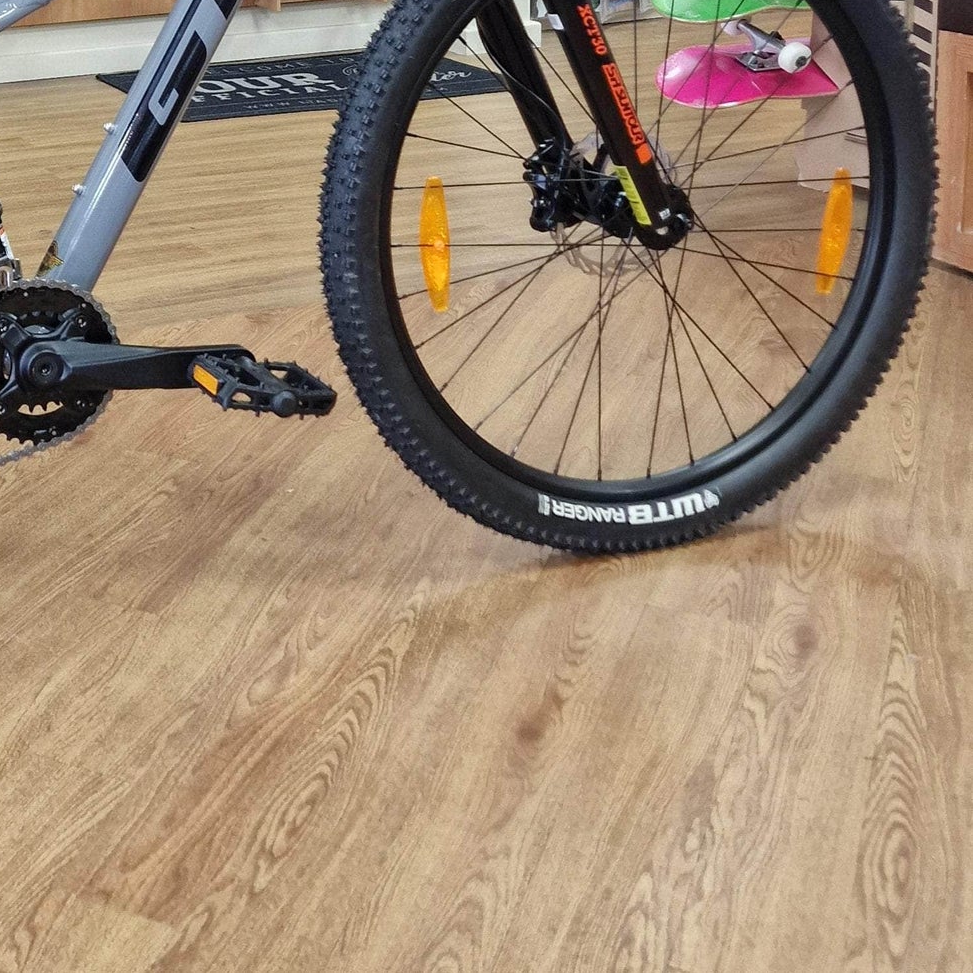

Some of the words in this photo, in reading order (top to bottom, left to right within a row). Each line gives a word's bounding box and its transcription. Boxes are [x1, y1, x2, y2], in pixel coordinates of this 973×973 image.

[192, 84, 351, 105] FFICIAL
[197, 71, 335, 95] OUR
[552, 499, 627, 524] RANGER
[627, 492, 707, 526] WTB
